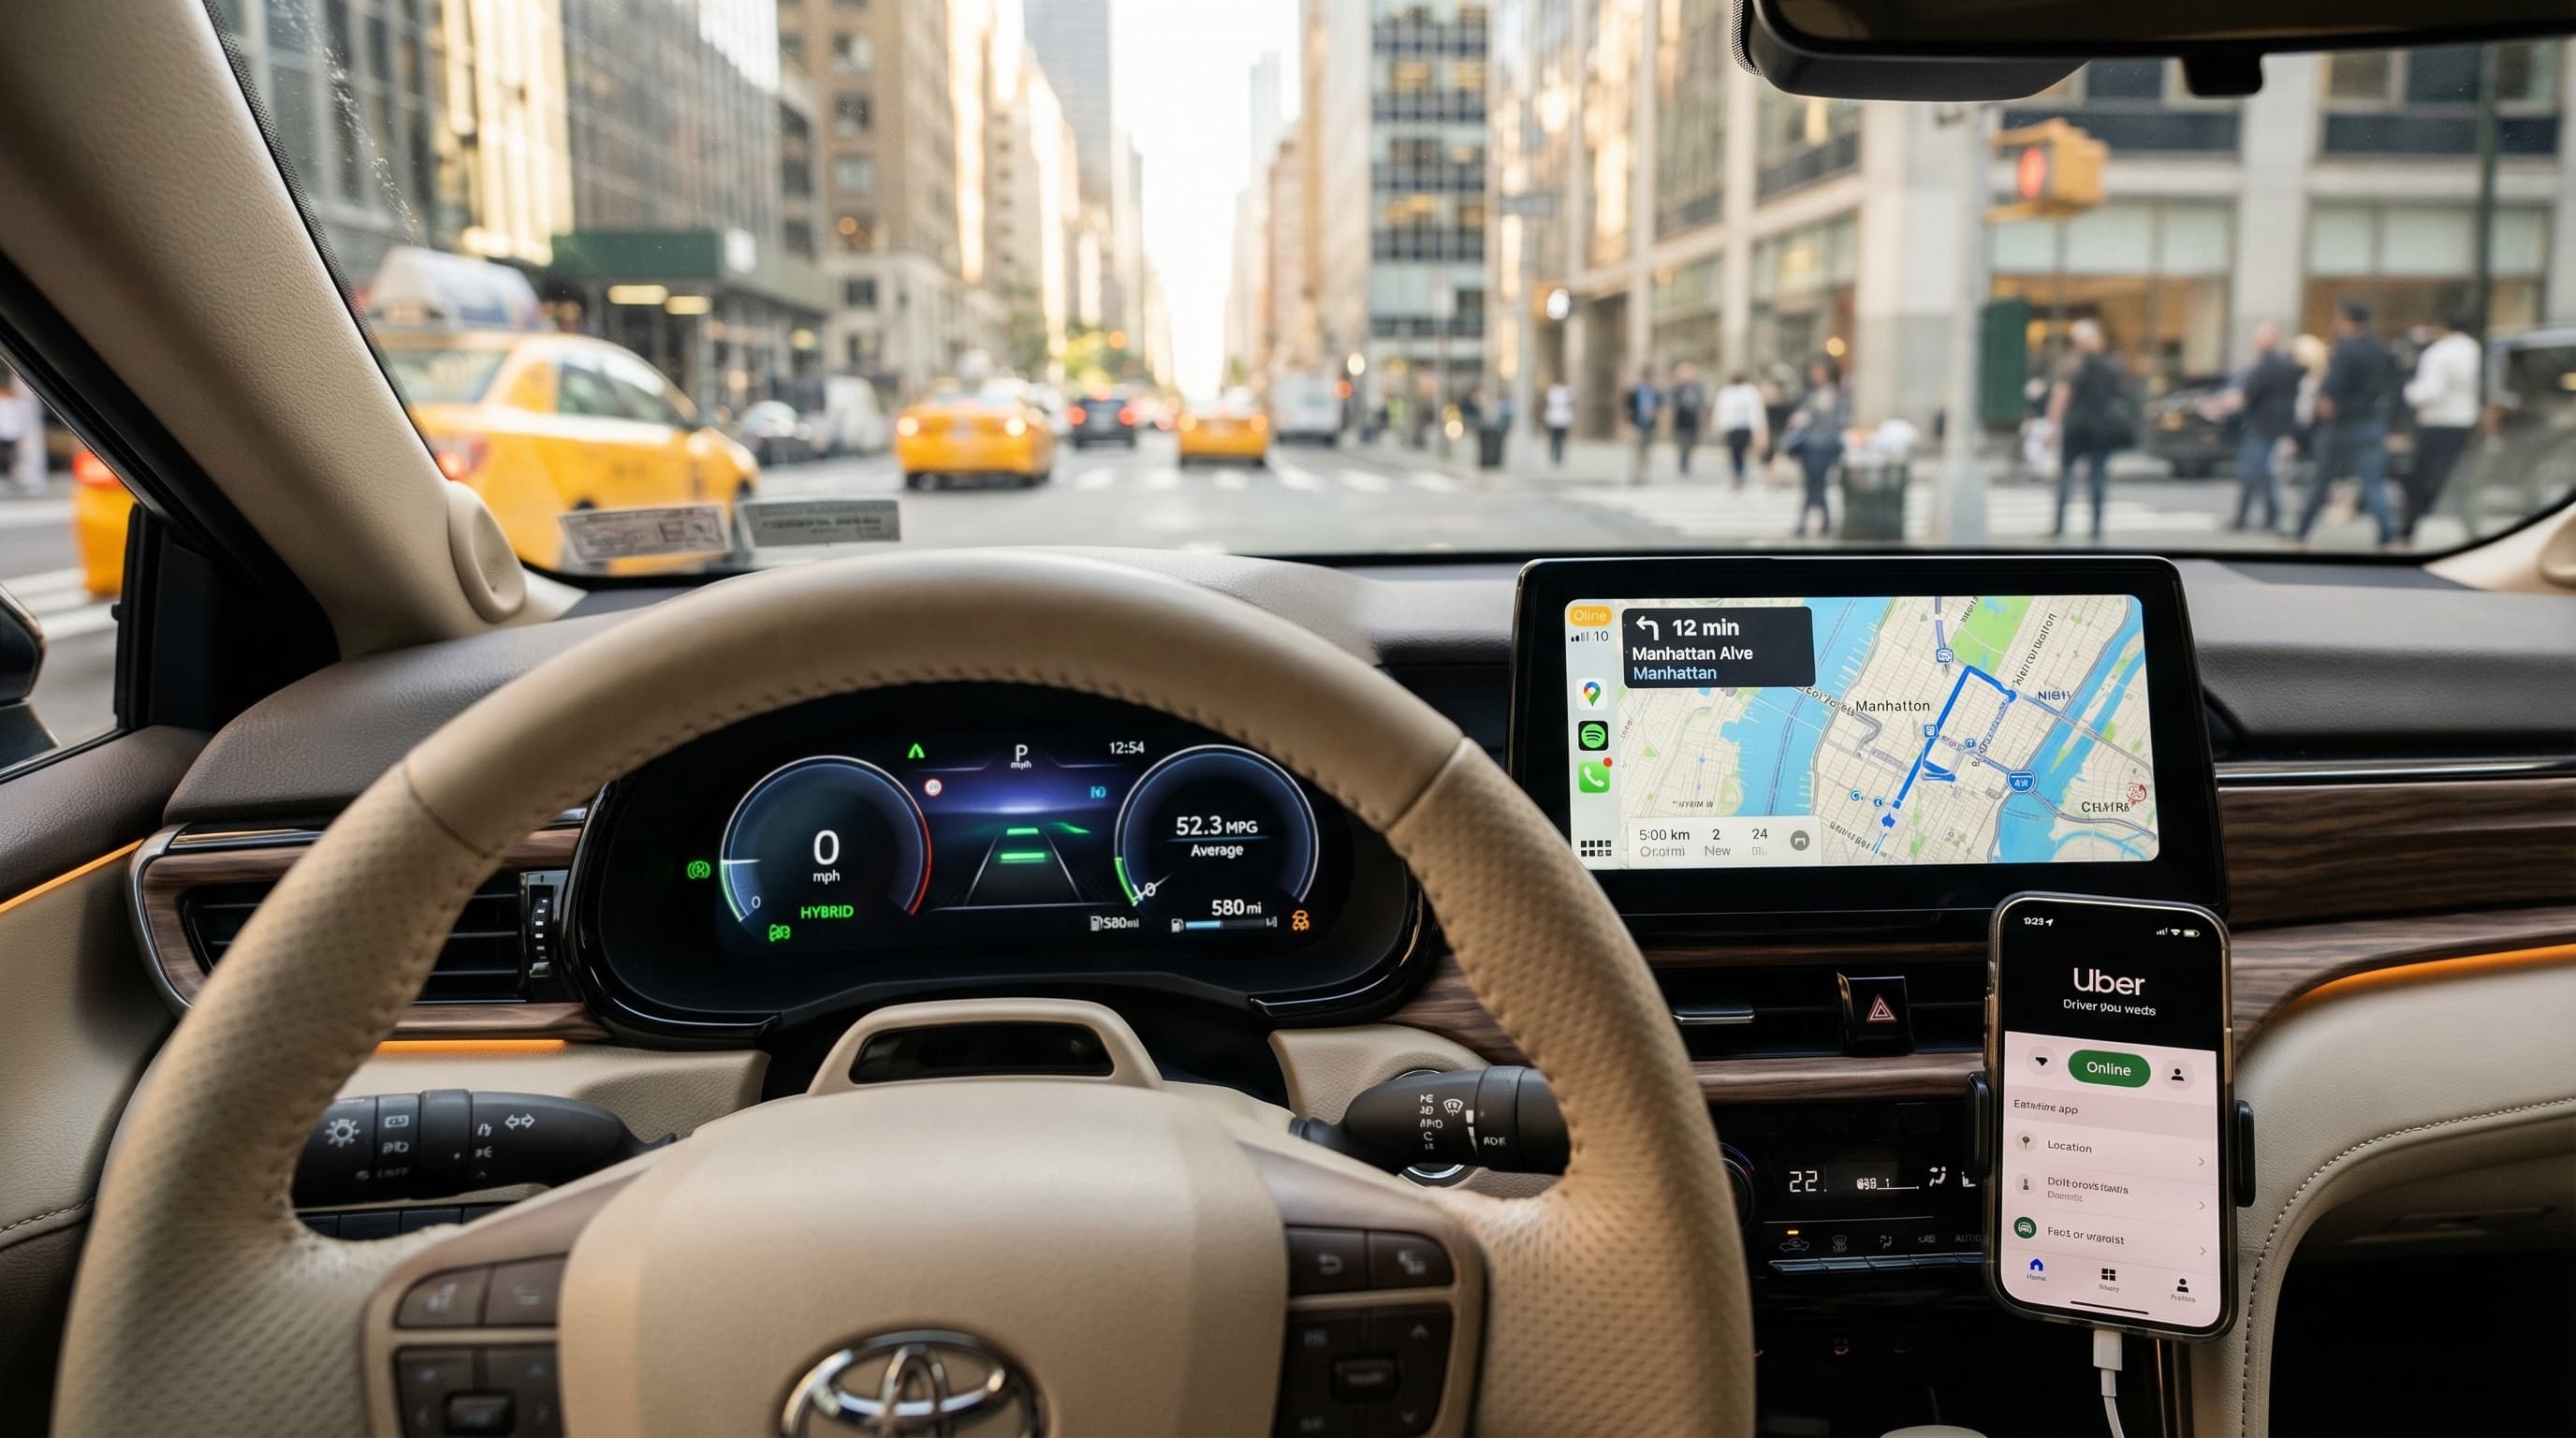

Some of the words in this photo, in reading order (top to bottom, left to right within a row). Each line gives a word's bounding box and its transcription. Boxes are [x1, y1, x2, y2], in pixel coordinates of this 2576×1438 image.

[1573, 609, 1607, 622] Oline
[1672, 619, 1697, 637] 12
[1703, 618, 1740, 637] min
[1632, 646, 1717, 661] Manhattan
[1720, 646, 1753, 660] Alve
[1633, 666, 1718, 681] Manhattan
[1855, 699, 1931, 712] Manhatton
[1015, 743, 1029, 762] P
[1108, 741, 1146, 755] 12:54
[1175, 815, 1223, 836] 52.3
[1225, 820, 1259, 834] MPG
[1639, 829, 1667, 841] 5:00
[1670, 829, 1690, 841] km
[1712, 828, 1721, 841] 2
[1751, 828, 1768, 840] 24
[812, 829, 841, 866] 0
[1191, 844, 1245, 858] Average
[1705, 845, 1732, 857] New
[812, 869, 841, 885] mph
[751, 895, 762, 909] 0
[1211, 899, 1245, 916] 580
[1246, 901, 1262, 915] mi
[800, 904, 855, 919] HYBRID
[2072, 967, 2146, 996] Uber
[2063, 998, 2098, 1011] Driver
[2086, 1061, 2132, 1077] Online
[2058, 1106, 2079, 1116] app
[2047, 1140, 2093, 1153] Location
[2072, 1230, 2085, 1240] or
